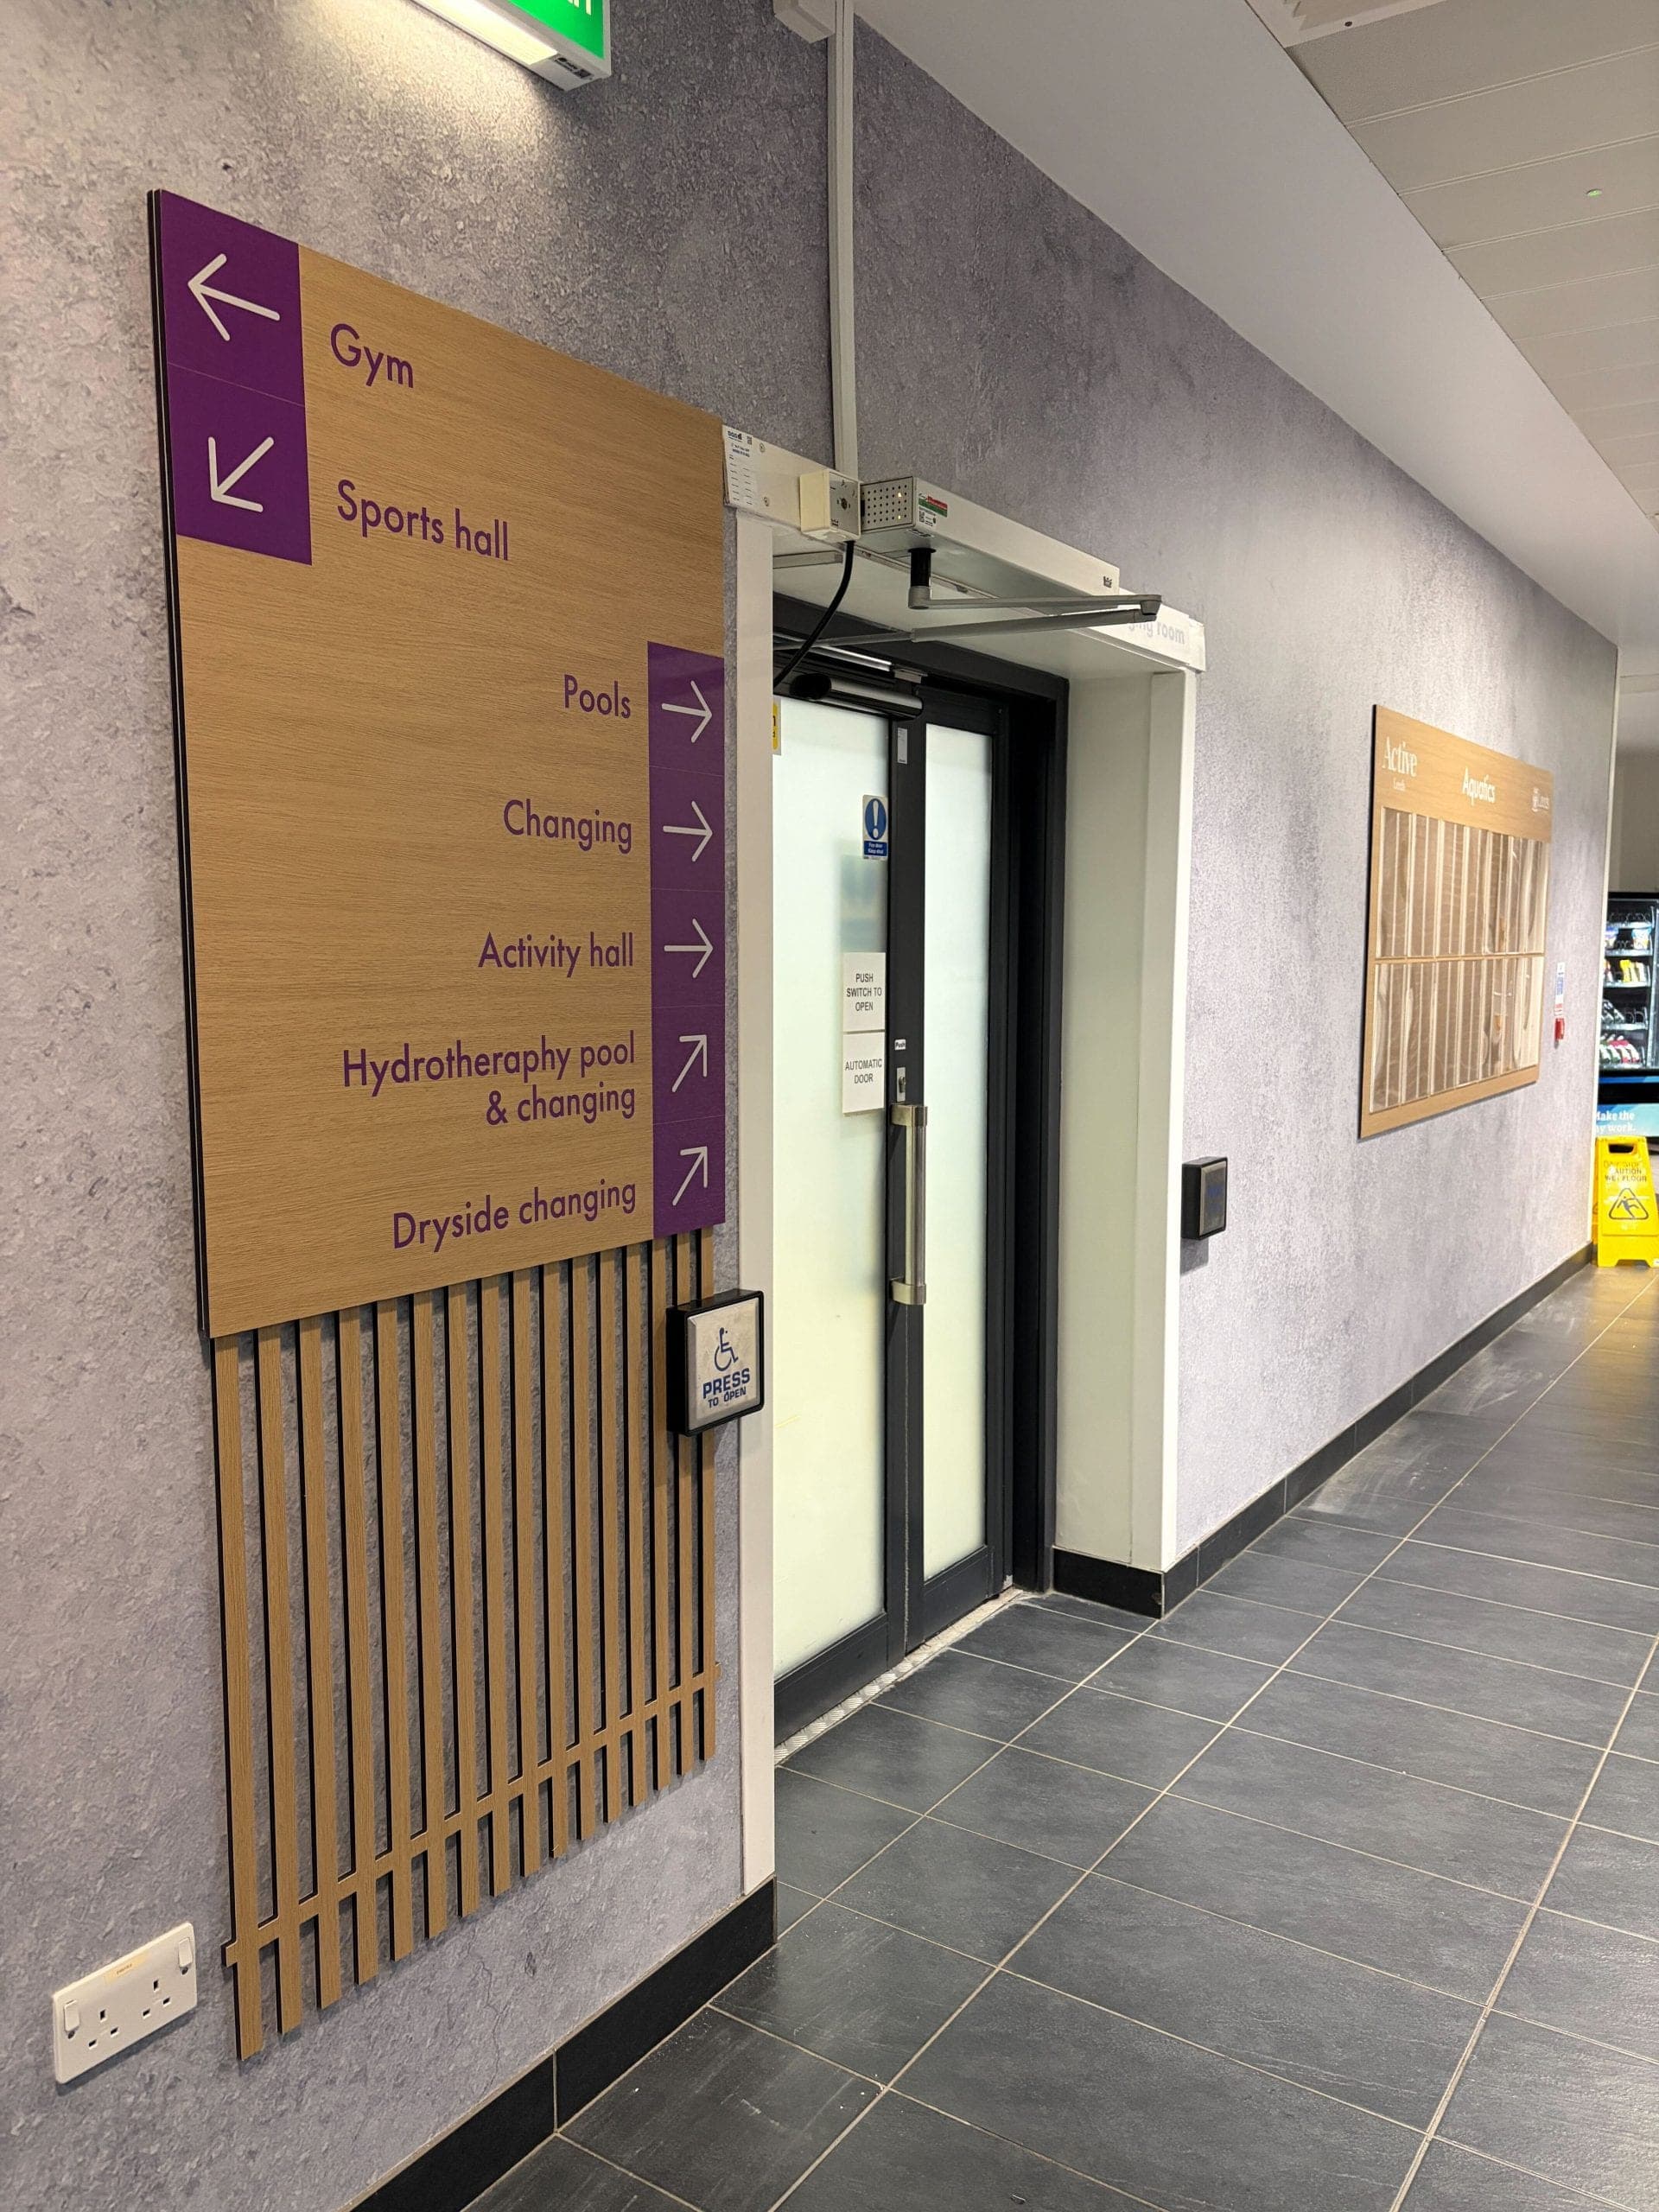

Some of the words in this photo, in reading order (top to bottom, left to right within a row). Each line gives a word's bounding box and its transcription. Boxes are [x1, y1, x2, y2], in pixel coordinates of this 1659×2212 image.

[330, 323, 414, 389] Gym
[338, 480, 444, 545] Sports
[455, 508, 508, 561] hall
[1157, 621, 1185, 645] room
[564, 674, 631, 719] Pools
[1382, 736, 1418, 778] Active
[1462, 766, 1496, 806] Aquatics
[503, 798, 632, 854] Changing
[478, 931, 581, 978] Activity
[590, 931, 633, 967] hall
[846, 987, 872, 998] SWITCH
[874, 987, 882, 996] TO
[855, 973, 874, 983] PUSH
[855, 1001, 874, 1012] OPEN
[343, 1035, 571, 1097] Hydrotheraphy
[580, 1030, 635, 1077] pool
[845, 1058, 882, 1071] AUTOMATIC
[854, 1073, 874, 1084] DOOR
[486, 1090, 508, 1126] &
[517, 1082, 635, 1123] changing
[1619, 1109, 1635, 1121] the
[393, 1195, 508, 1253] Dryside
[518, 1179, 636, 1222] changing
[702, 1368, 750, 1399] PRESS
[709, 1397, 719, 1408] TO
[724, 1387, 747, 1402] OPEN
